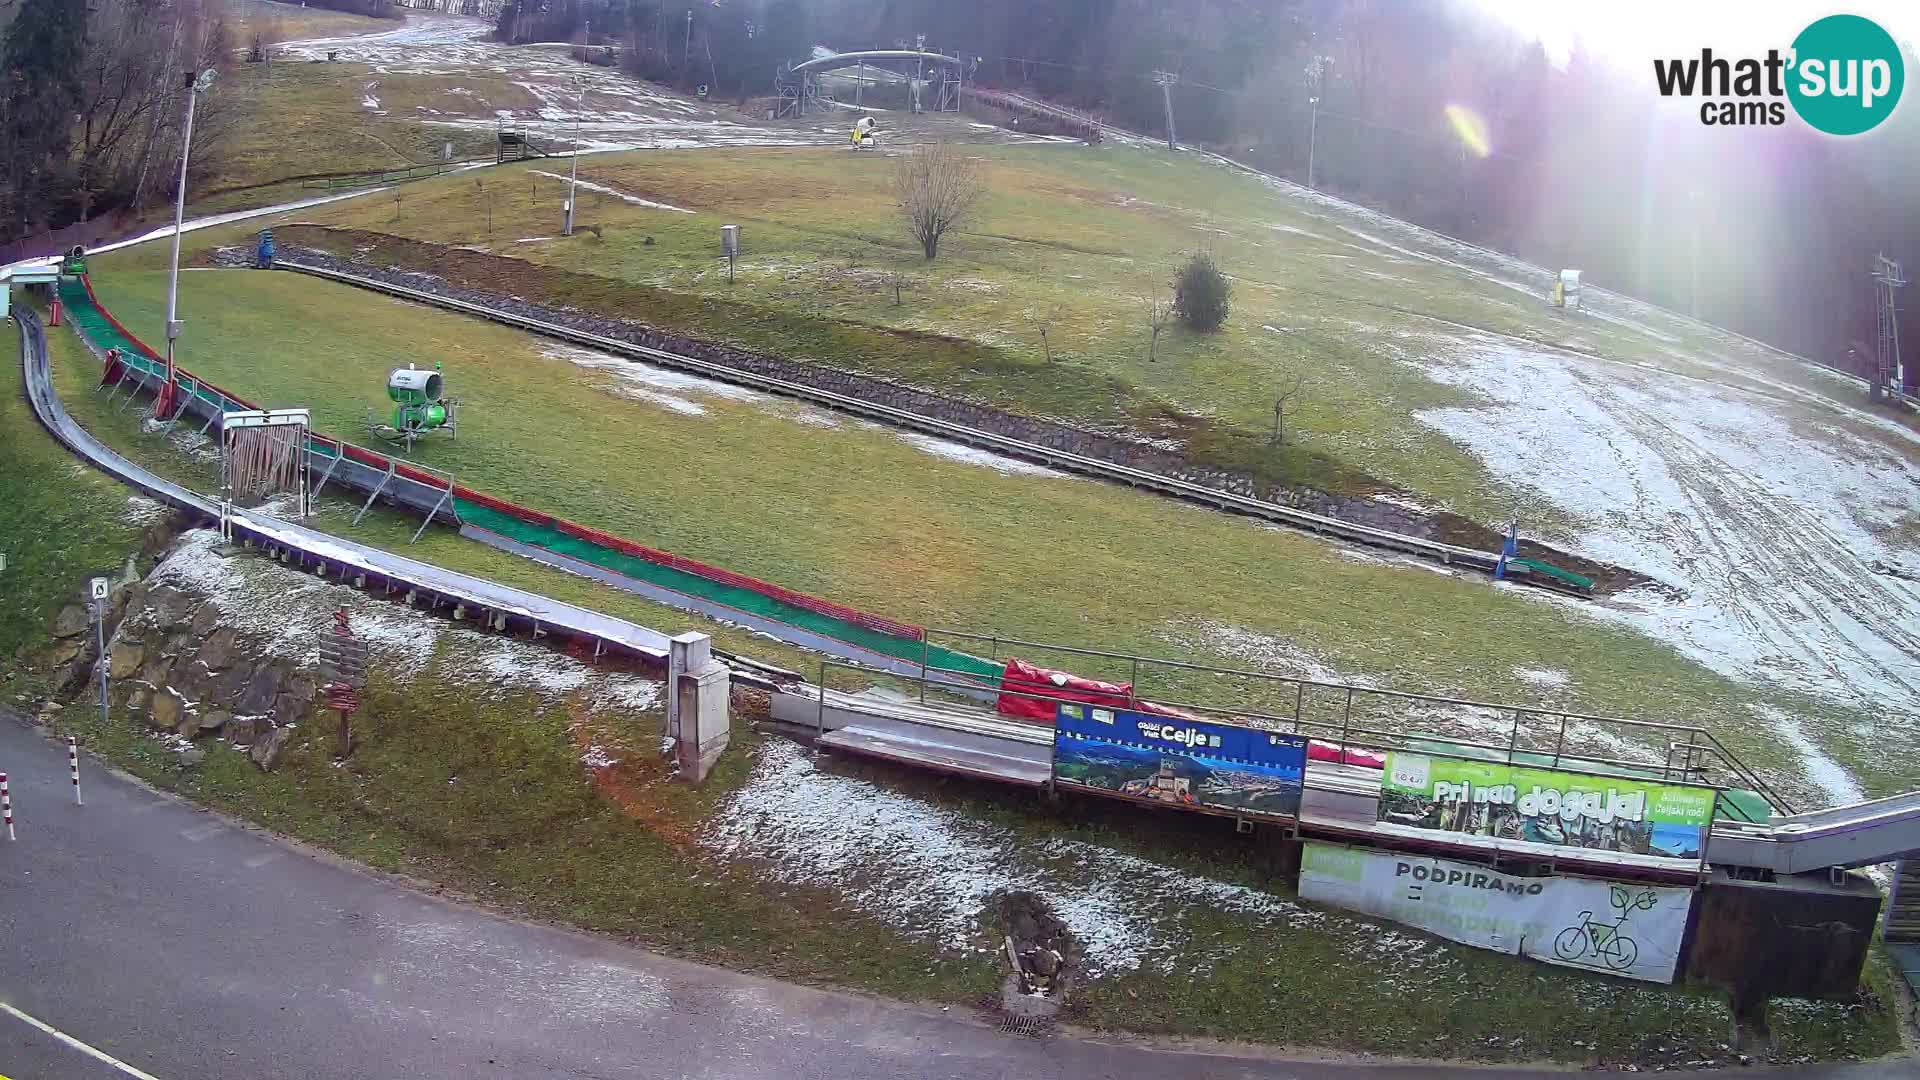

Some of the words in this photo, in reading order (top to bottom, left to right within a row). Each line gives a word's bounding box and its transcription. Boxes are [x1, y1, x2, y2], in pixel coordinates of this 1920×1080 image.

[1161, 725, 1207, 748] Celje
[1433, 780, 1470, 804] Pri
[1474, 784, 1516, 805] nas
[1518, 786, 1645, 824] dogaja!
[1395, 861, 1544, 896] PODPIRAMO
